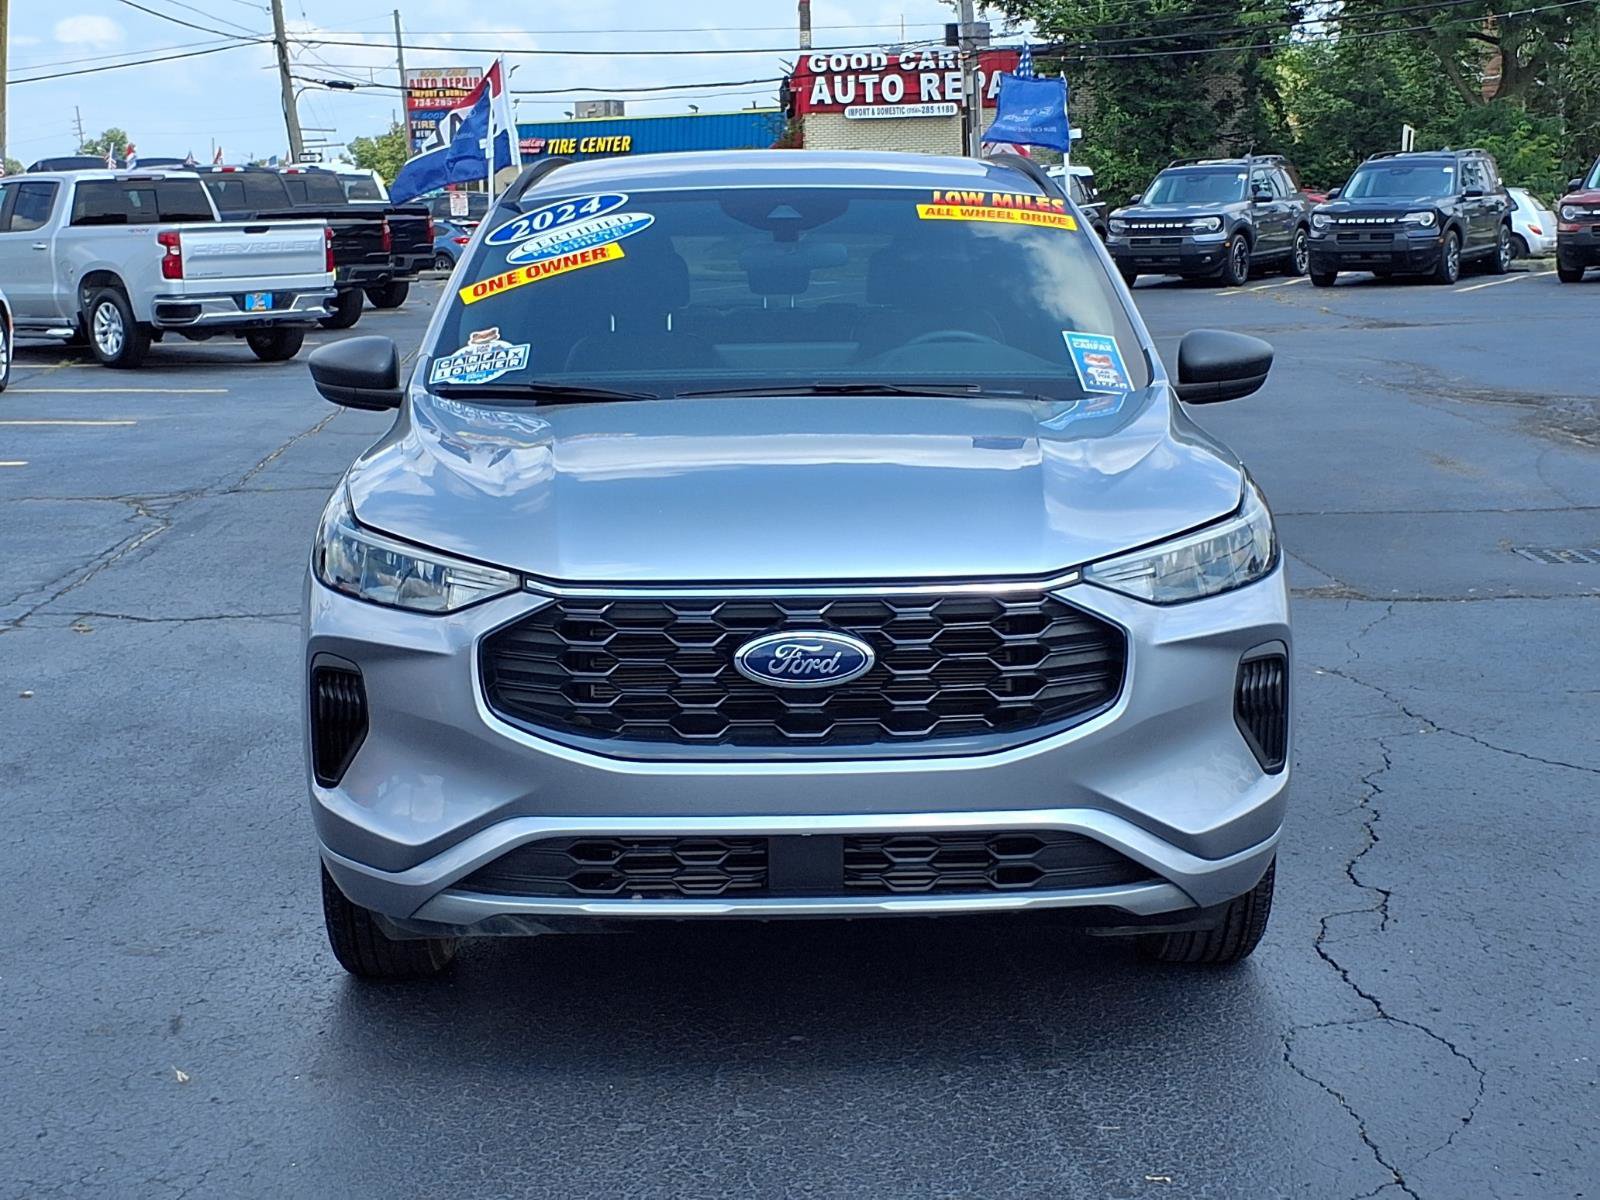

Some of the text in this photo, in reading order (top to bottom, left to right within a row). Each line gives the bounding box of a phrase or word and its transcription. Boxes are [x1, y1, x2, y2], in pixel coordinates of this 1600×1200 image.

[809, 50, 962, 73] GOOD CAR
[810, 73, 904, 104] AUTO
[848, 107, 870, 117] IMPORT
[877, 105, 906, 115] DOMESTIC
[547, 135, 631, 155] TIRE CENTER
[933, 190, 1065, 213] LOW MILES
[511, 196, 601, 240] 2024
[925, 207, 1067, 226] ALL WHEEL DRIVE
[194, 240, 317, 255] CHEVROLET
[473, 247, 607, 297] ONE OWNER
[440, 350, 521, 369] CARFAX
[768, 644, 842, 674] Ford
